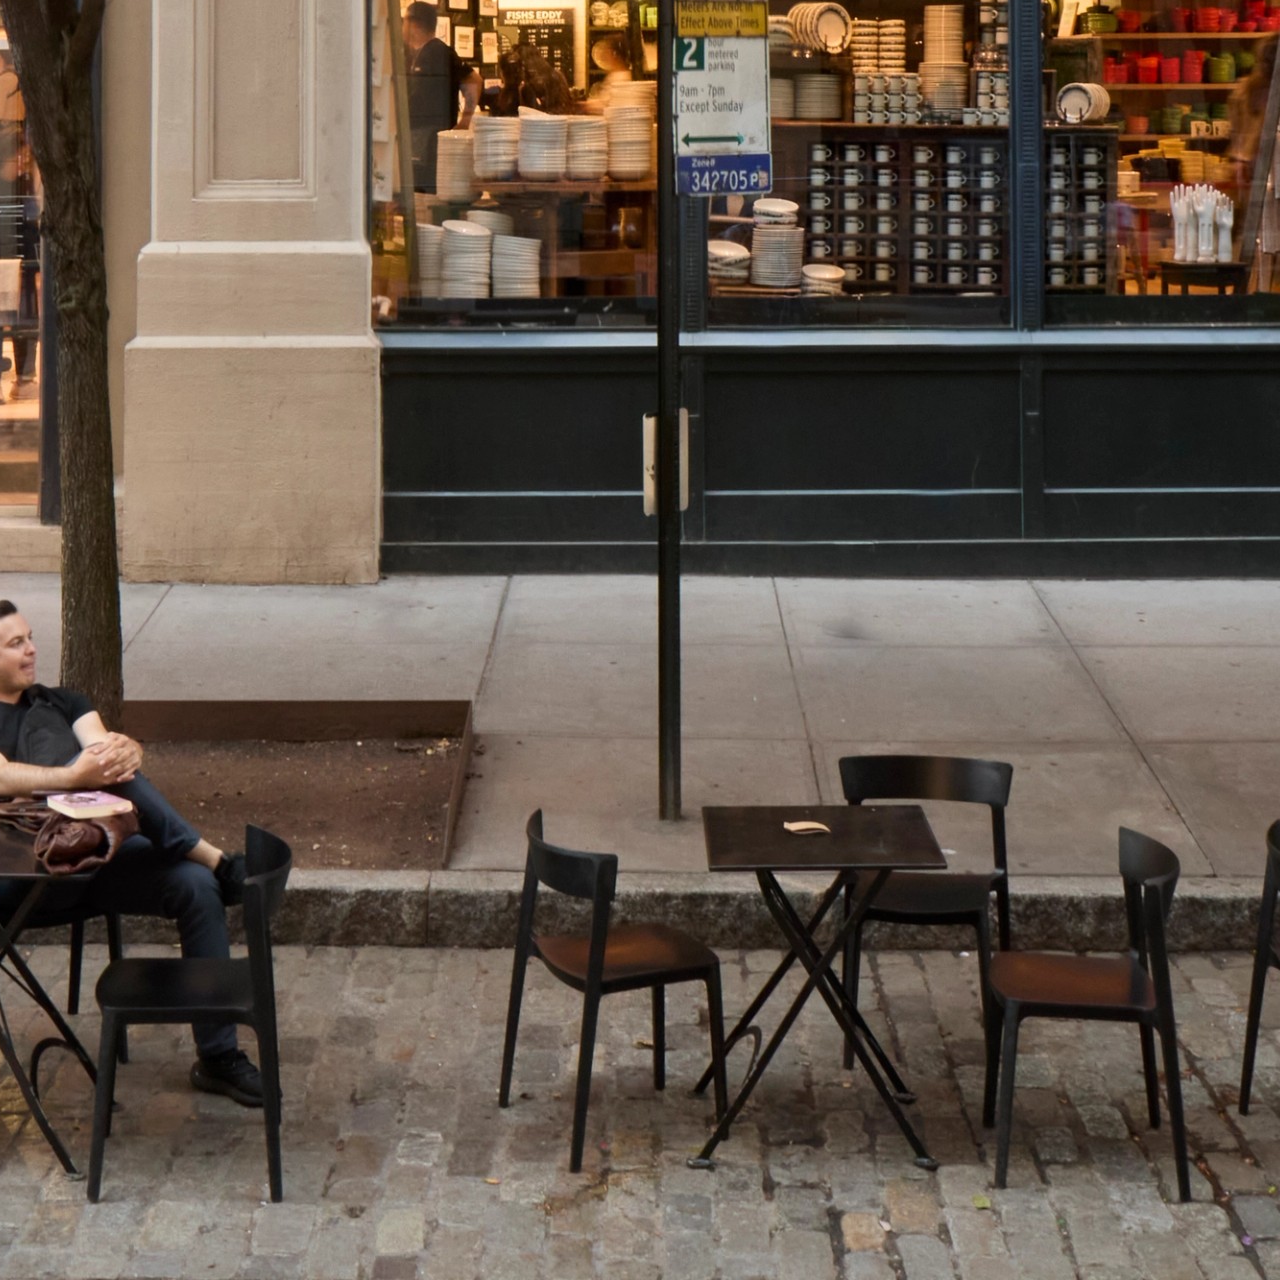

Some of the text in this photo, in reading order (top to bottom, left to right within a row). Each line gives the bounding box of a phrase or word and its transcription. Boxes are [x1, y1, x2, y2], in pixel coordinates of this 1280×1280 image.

[506, 11, 562, 20] FISHS EDDY
[681, 17, 759, 29] Effect Above Times
[708, 38, 724, 47] hour
[683, 38, 697, 68] 2
[708, 49, 738, 59] metered
[708, 62, 735, 72] parking
[680, 86, 698, 97] 9am
[708, 85, 725, 98] 7pm
[680, 100, 744, 114] Except Sunday
[692, 170, 748, 191] 342705
